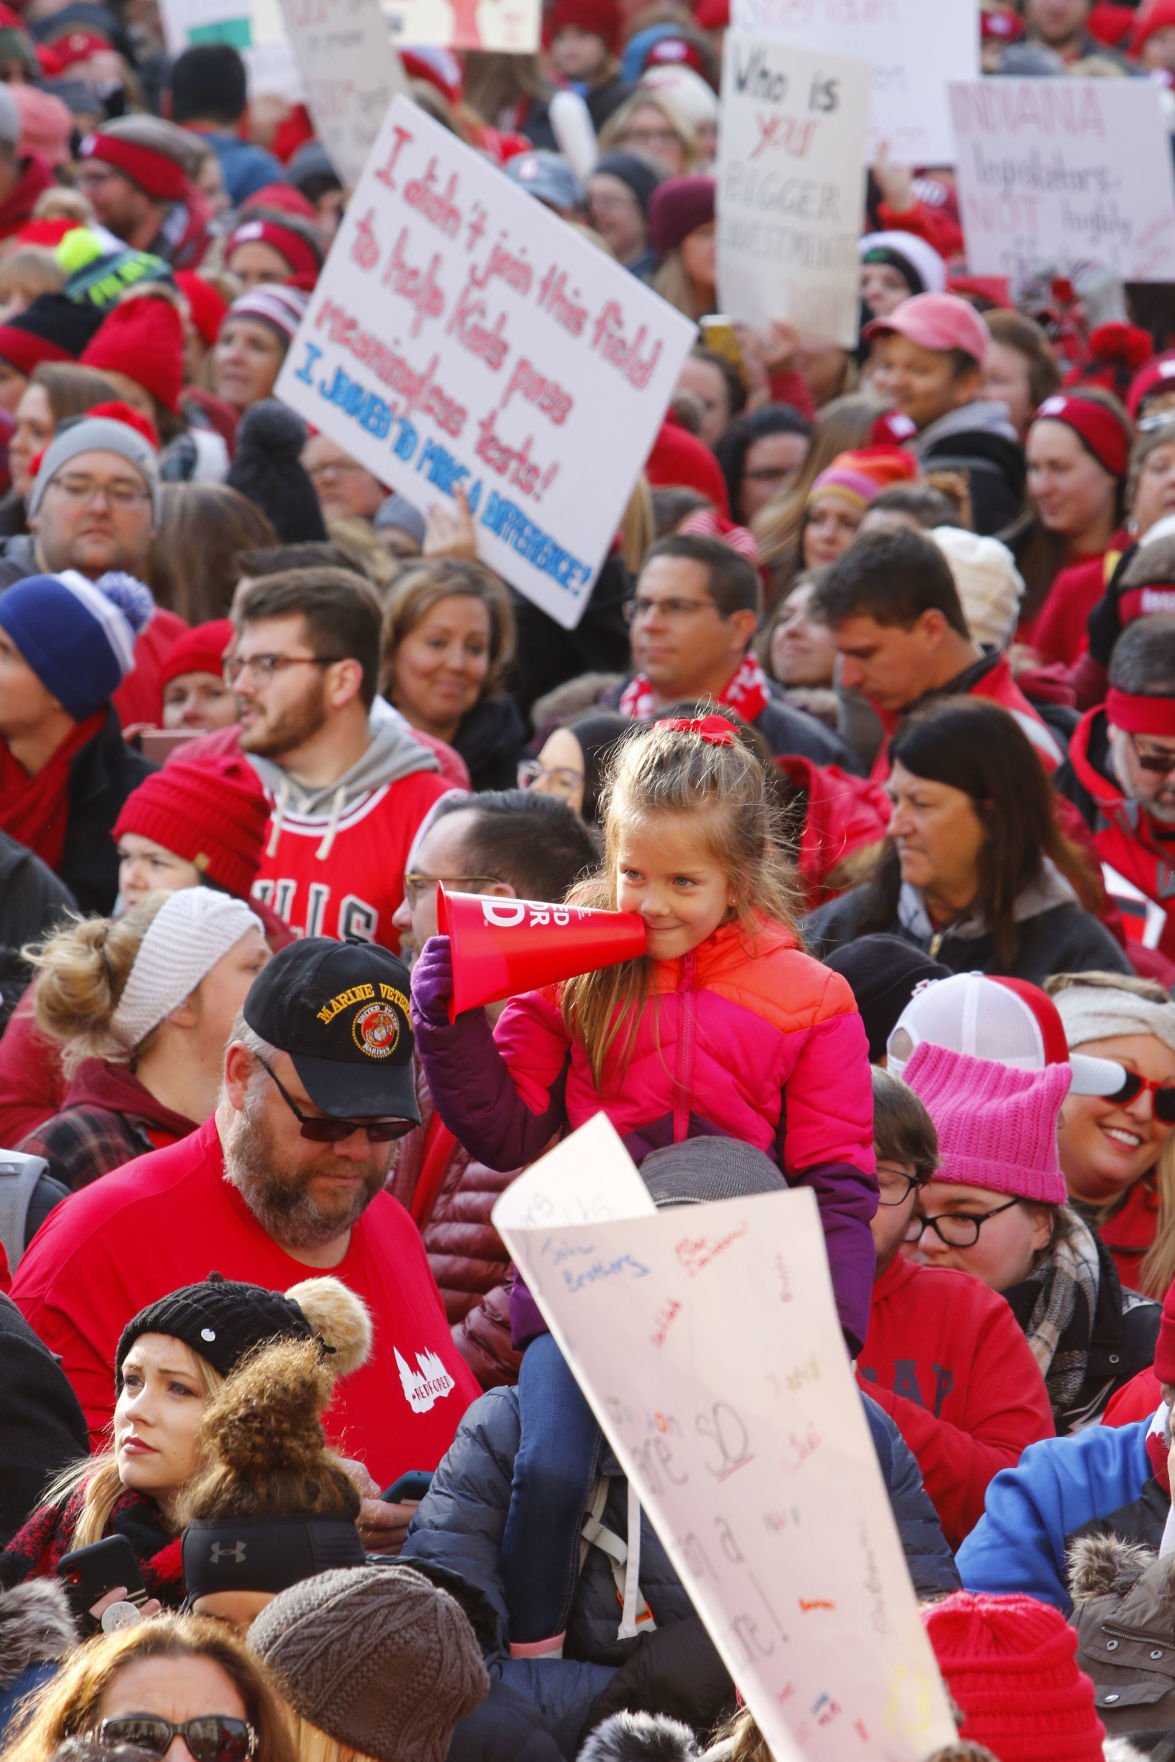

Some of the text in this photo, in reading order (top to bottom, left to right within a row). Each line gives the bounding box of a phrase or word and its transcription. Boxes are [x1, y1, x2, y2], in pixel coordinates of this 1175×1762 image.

[733, 46, 786, 104] Who
[725, 160, 842, 224] BIGGER
[966, 191, 1040, 236] NOT
[374, 124, 664, 391] I didn't join this field
[351, 207, 380, 270] to
[383, 225, 444, 338] help
[500, 355, 574, 426] pass
[294, 341, 322, 386] I
[319, 363, 392, 440] JOINED
[474, 408, 560, 503] tests!
[316, 982, 413, 1031] MARINE VETER
[861, 1359, 954, 1418] AP
